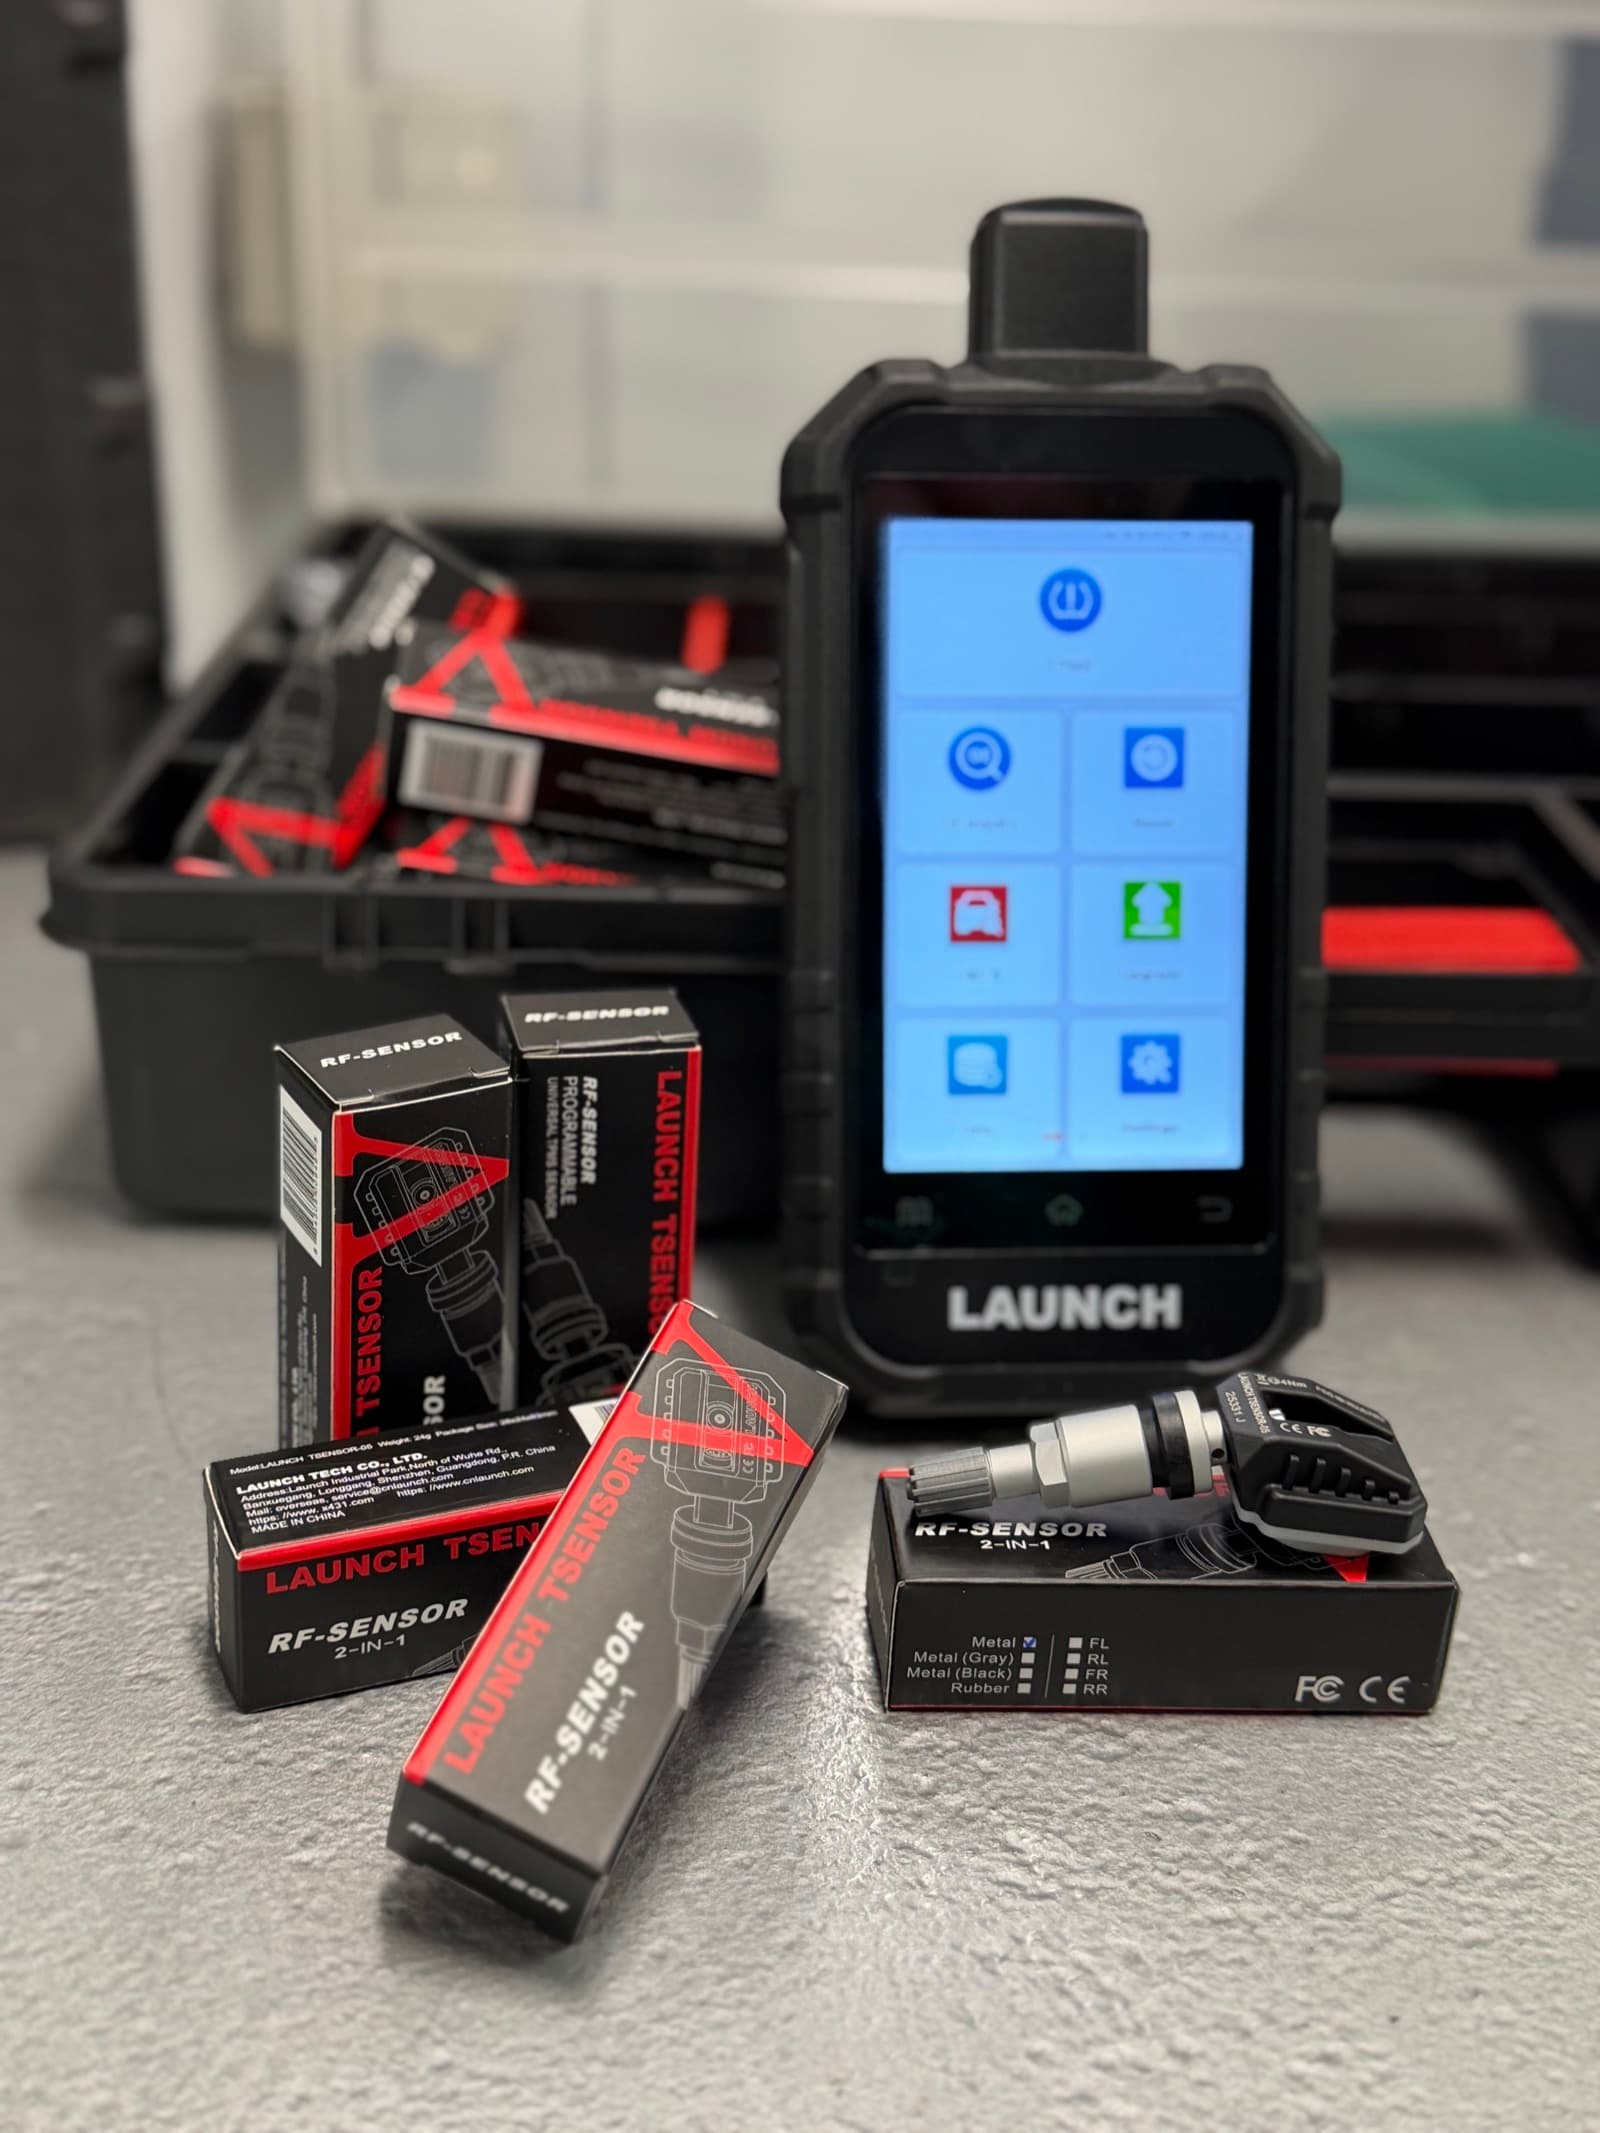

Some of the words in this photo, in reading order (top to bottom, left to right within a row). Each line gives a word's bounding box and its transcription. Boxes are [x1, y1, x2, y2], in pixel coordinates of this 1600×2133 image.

[525, 1005, 669, 1023] RF-SENSOR
[320, 1031, 463, 1068] RF-SENSOR
[546, 1077, 559, 1138] UNIVERSAL
[560, 1076, 578, 1206] PROGRAMMABLE
[580, 1076, 598, 1184] RF-SENSOR
[653, 1071, 682, 1201] LAUNCH
[545, 1170, 558, 1219] SENSOR
[648, 1214, 677, 1334] TSENS
[946, 1283, 1184, 1331] LAUNCH
[356, 1266, 383, 1417] TSENSOR
[1237, 1372, 1253, 1399] LAUNCH
[1279, 1422, 1302, 1434] CE
[524, 1445, 557, 1457] China
[235, 1473, 306, 1495] LAUNCH
[308, 1465, 354, 1481] TECH
[356, 1460, 390, 1471] CO.,
[393, 1452, 428, 1464] LTD.
[330, 1468, 380, 1486] Industrial
[440, 1455, 450, 1464] of
[452, 1450, 484, 1462] Wuhe
[396, 1486, 427, 1498] https:
[245, 1507, 273, 1518] Mail:
[248, 1514, 280, 1526] https:
[251, 1520, 289, 1534] MADE
[291, 1517, 304, 1526] IN
[306, 1510, 346, 1523] CHINA
[915, 1522, 1108, 1538] RF-SENSOR
[265, 1544, 425, 1594] LAUNCH
[444, 1522, 540, 1560] TSEN
[980, 1539, 1051, 1551] 2-IN-1
[443, 1611, 552, 1778] LAUNCH
[540, 1445, 647, 1605] TSENSOR
[267, 1598, 469, 1654] RF-SENSOR
[334, 1634, 406, 1659] 2-IN-1
[971, 1636, 1016, 1648] Metal
[1089, 1637, 1110, 1649] FL
[913, 1651, 958, 1663] Metal
[962, 1652, 1014, 1666] (Gray)
[1087, 1653, 1109, 1665] RL
[906, 1667, 951, 1678] Metal
[955, 1667, 1013, 1680] (Black)
[1085, 1668, 1109, 1680] FR
[951, 1682, 1010, 1694] Rubber
[1083, 1683, 1108, 1695] RR
[1359, 1675, 1411, 1704] CE
[524, 1610, 647, 1814] RF-SENSOR
[588, 1684, 638, 1761] 2-IN-1
[405, 1821, 571, 1914] RF-SENSOR
